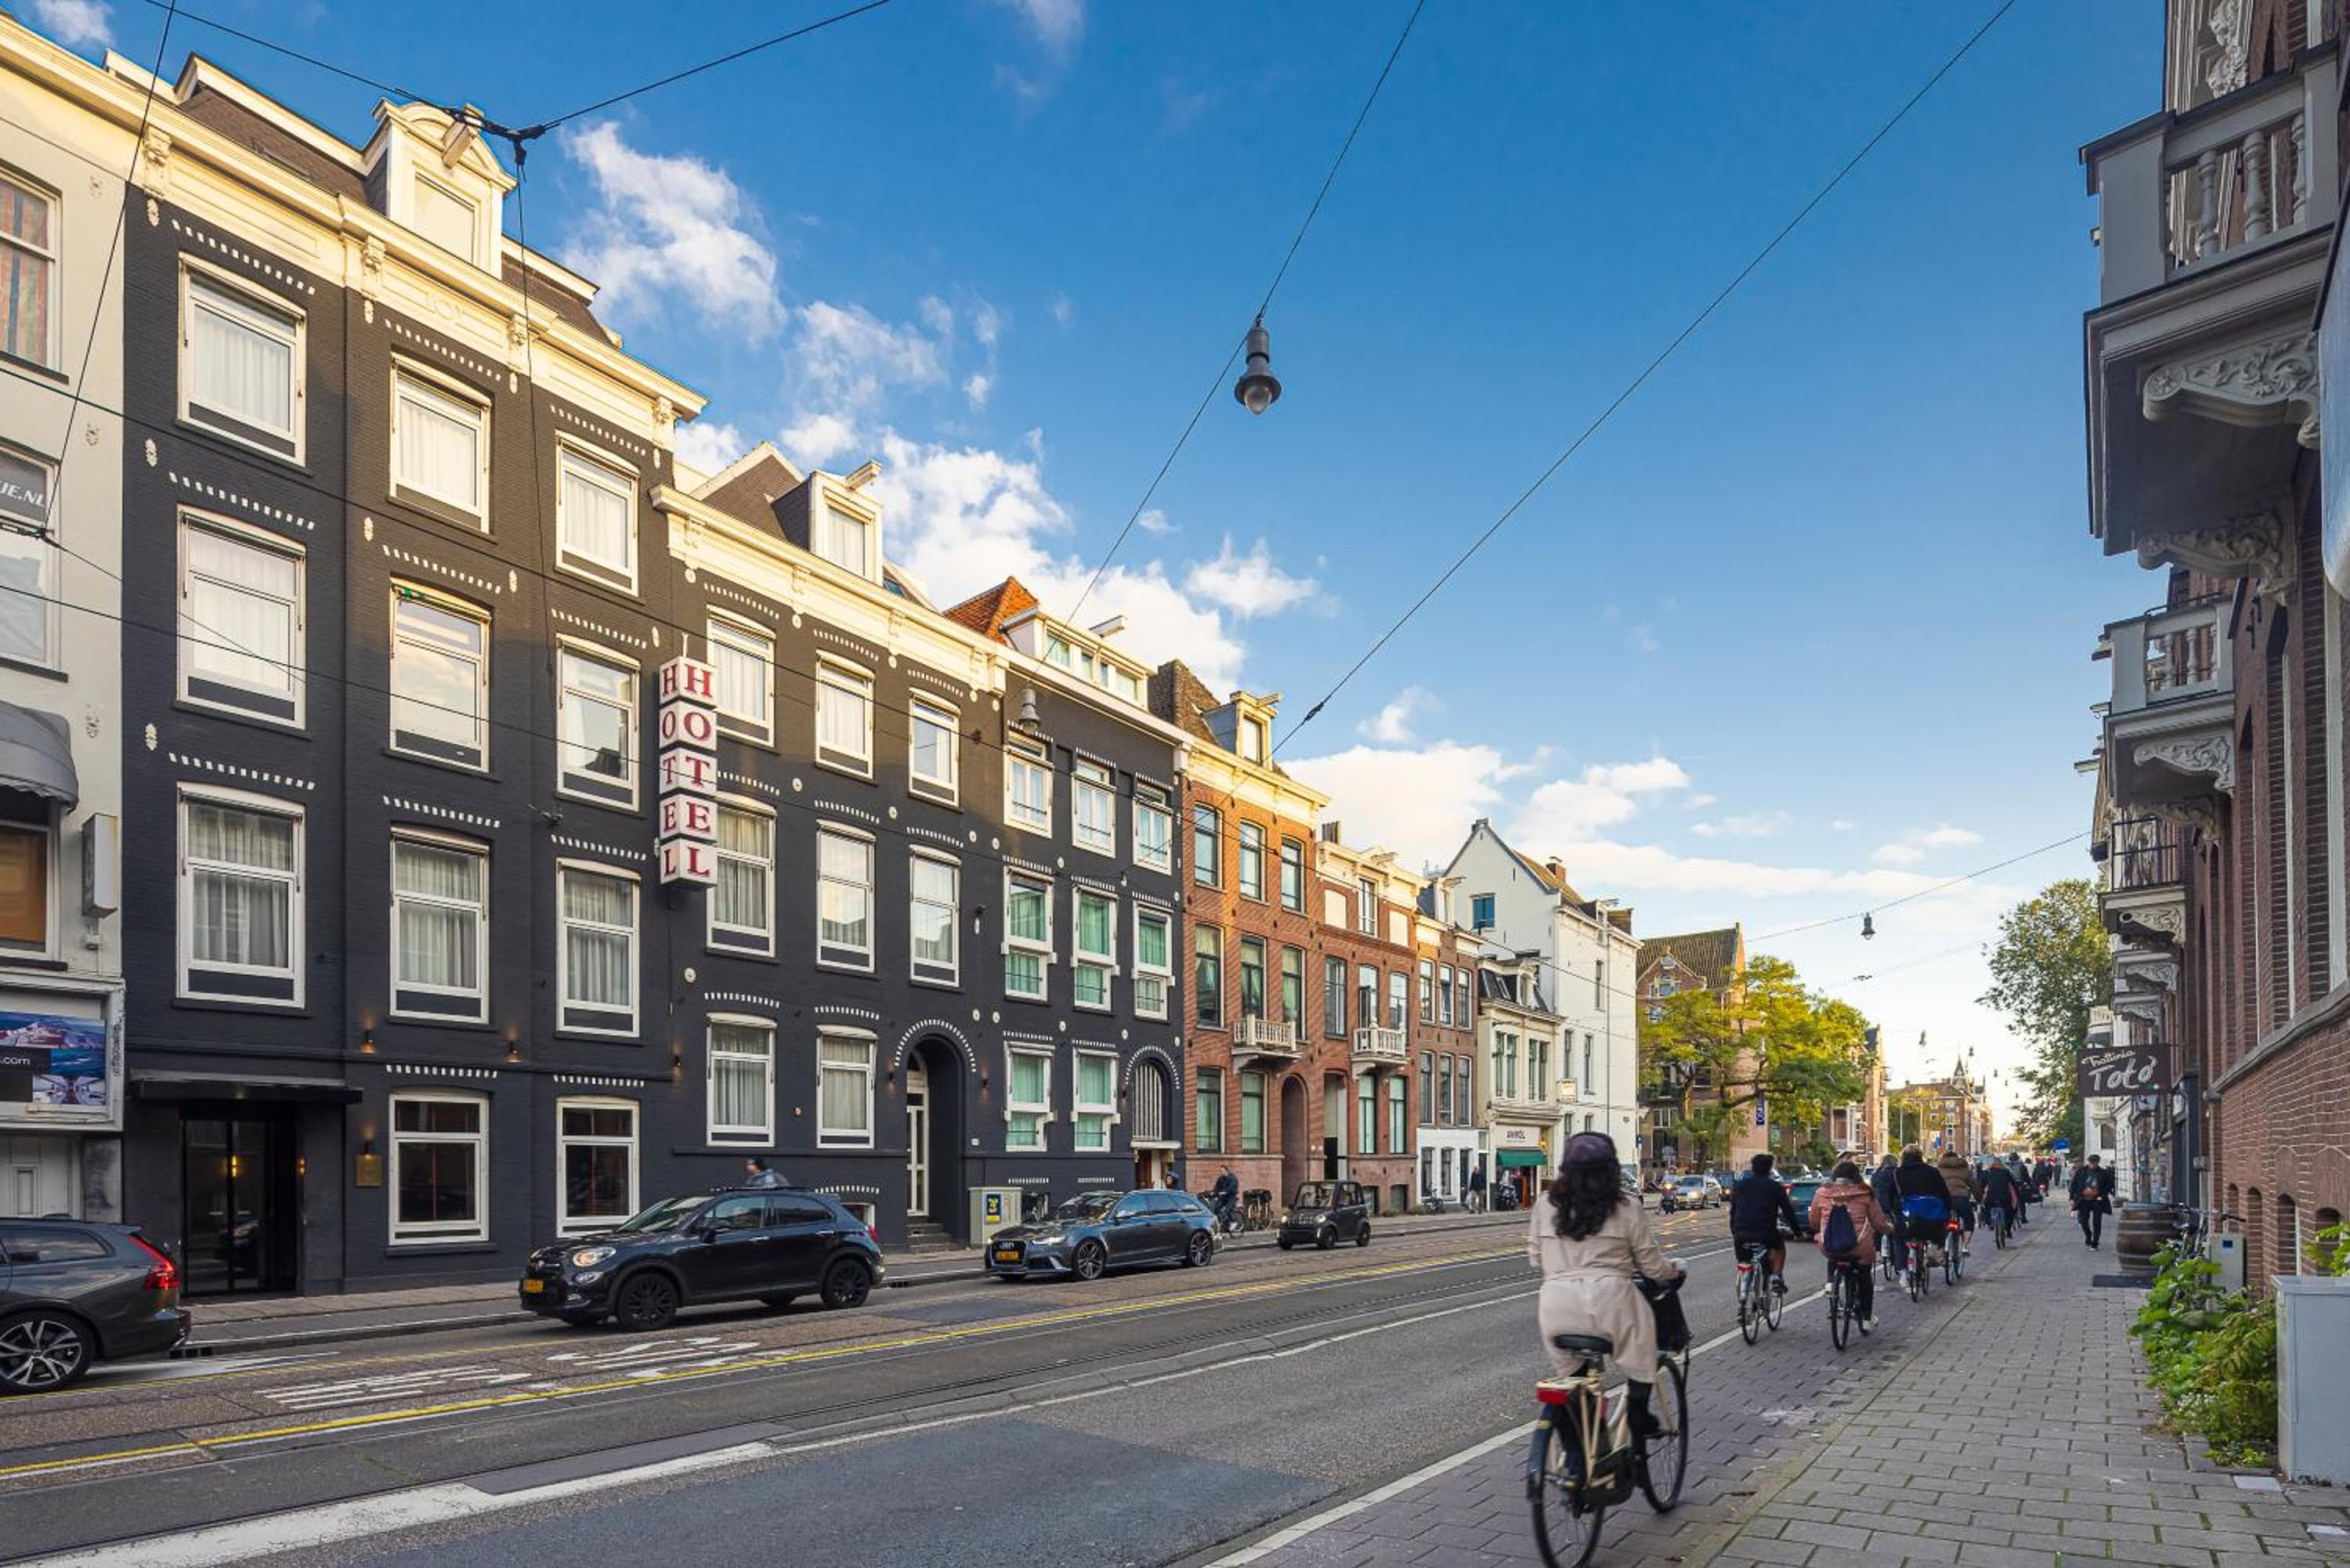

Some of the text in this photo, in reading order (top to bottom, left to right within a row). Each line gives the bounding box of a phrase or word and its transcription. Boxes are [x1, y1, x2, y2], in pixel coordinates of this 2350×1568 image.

[0, 480, 45, 508] JE.NL
[662, 665, 678, 876] HOTEL
[684, 664, 712, 877] HOTEL
[0, 1057, 31, 1065] .com
[2081, 1050, 2136, 1067] Trattoria
